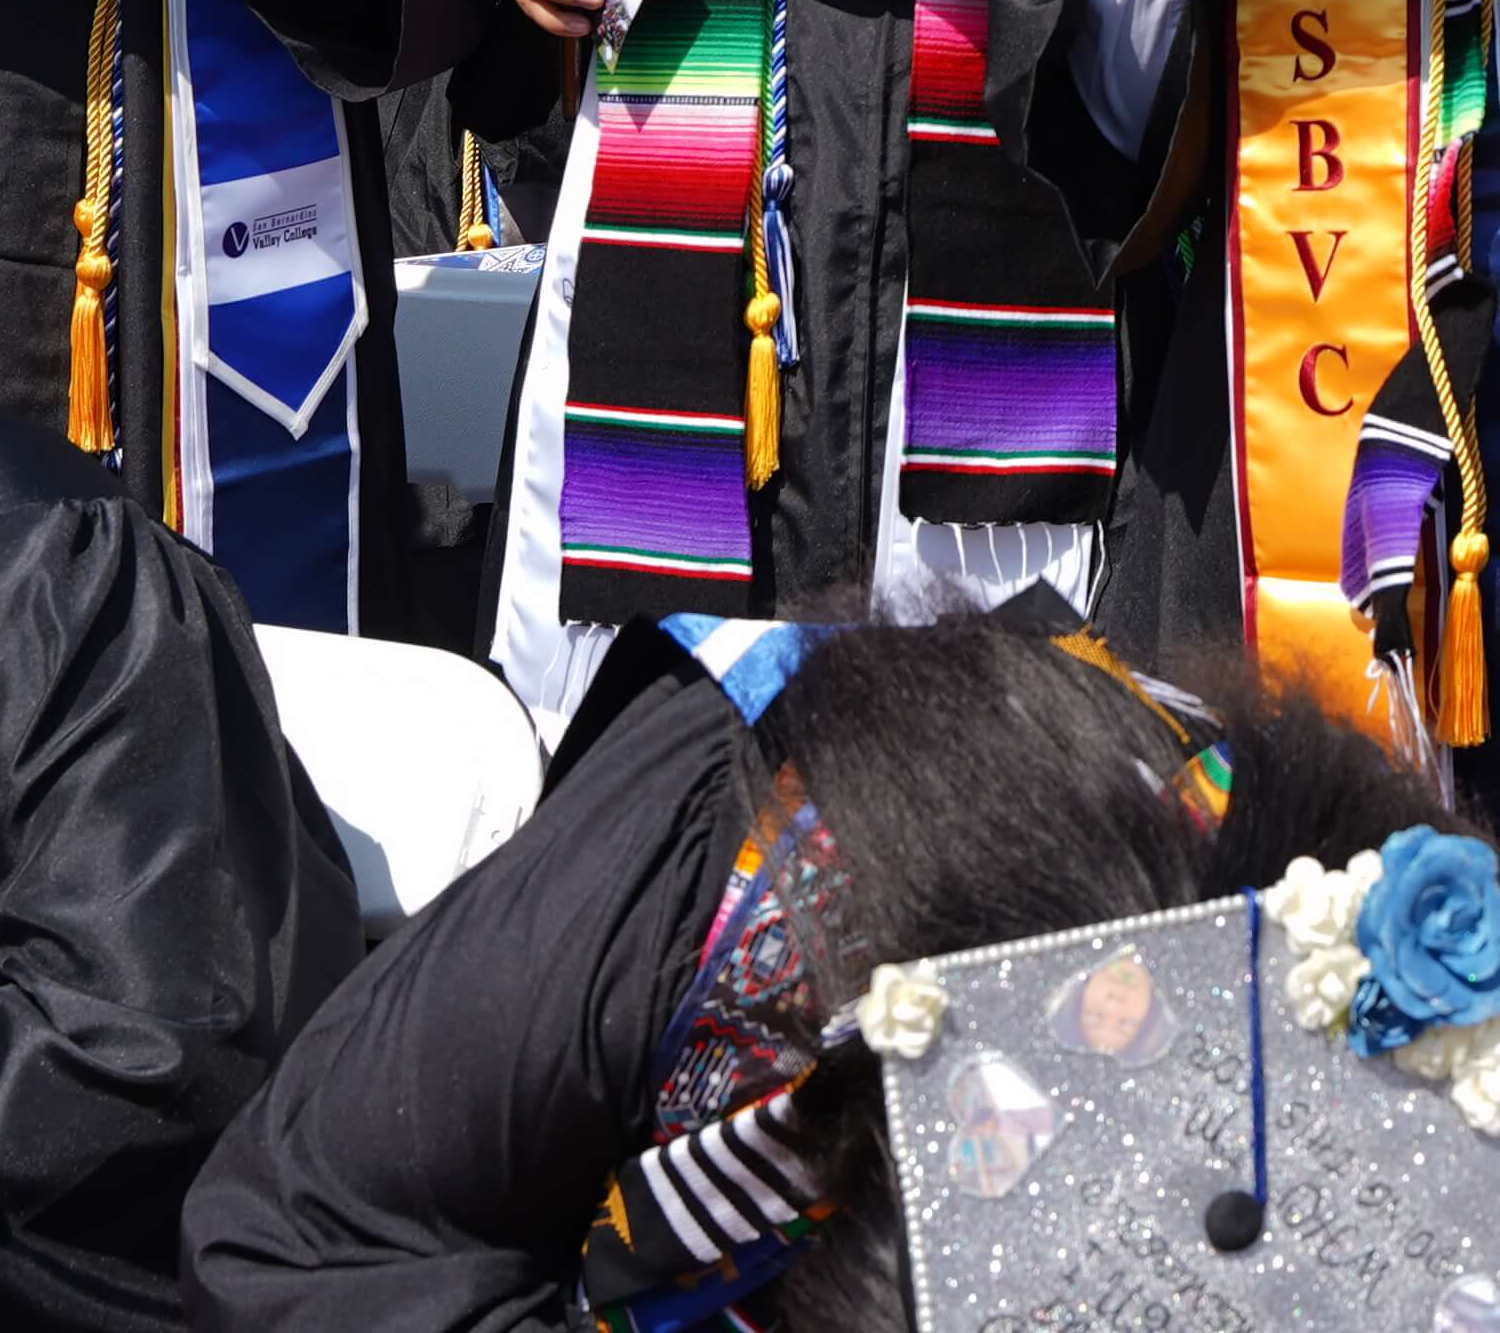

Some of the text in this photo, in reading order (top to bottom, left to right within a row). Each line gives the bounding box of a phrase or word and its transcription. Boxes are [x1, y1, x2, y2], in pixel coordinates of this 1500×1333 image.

[271, 210, 317, 228] Bernardino
[253, 226, 318, 251] Valley College
